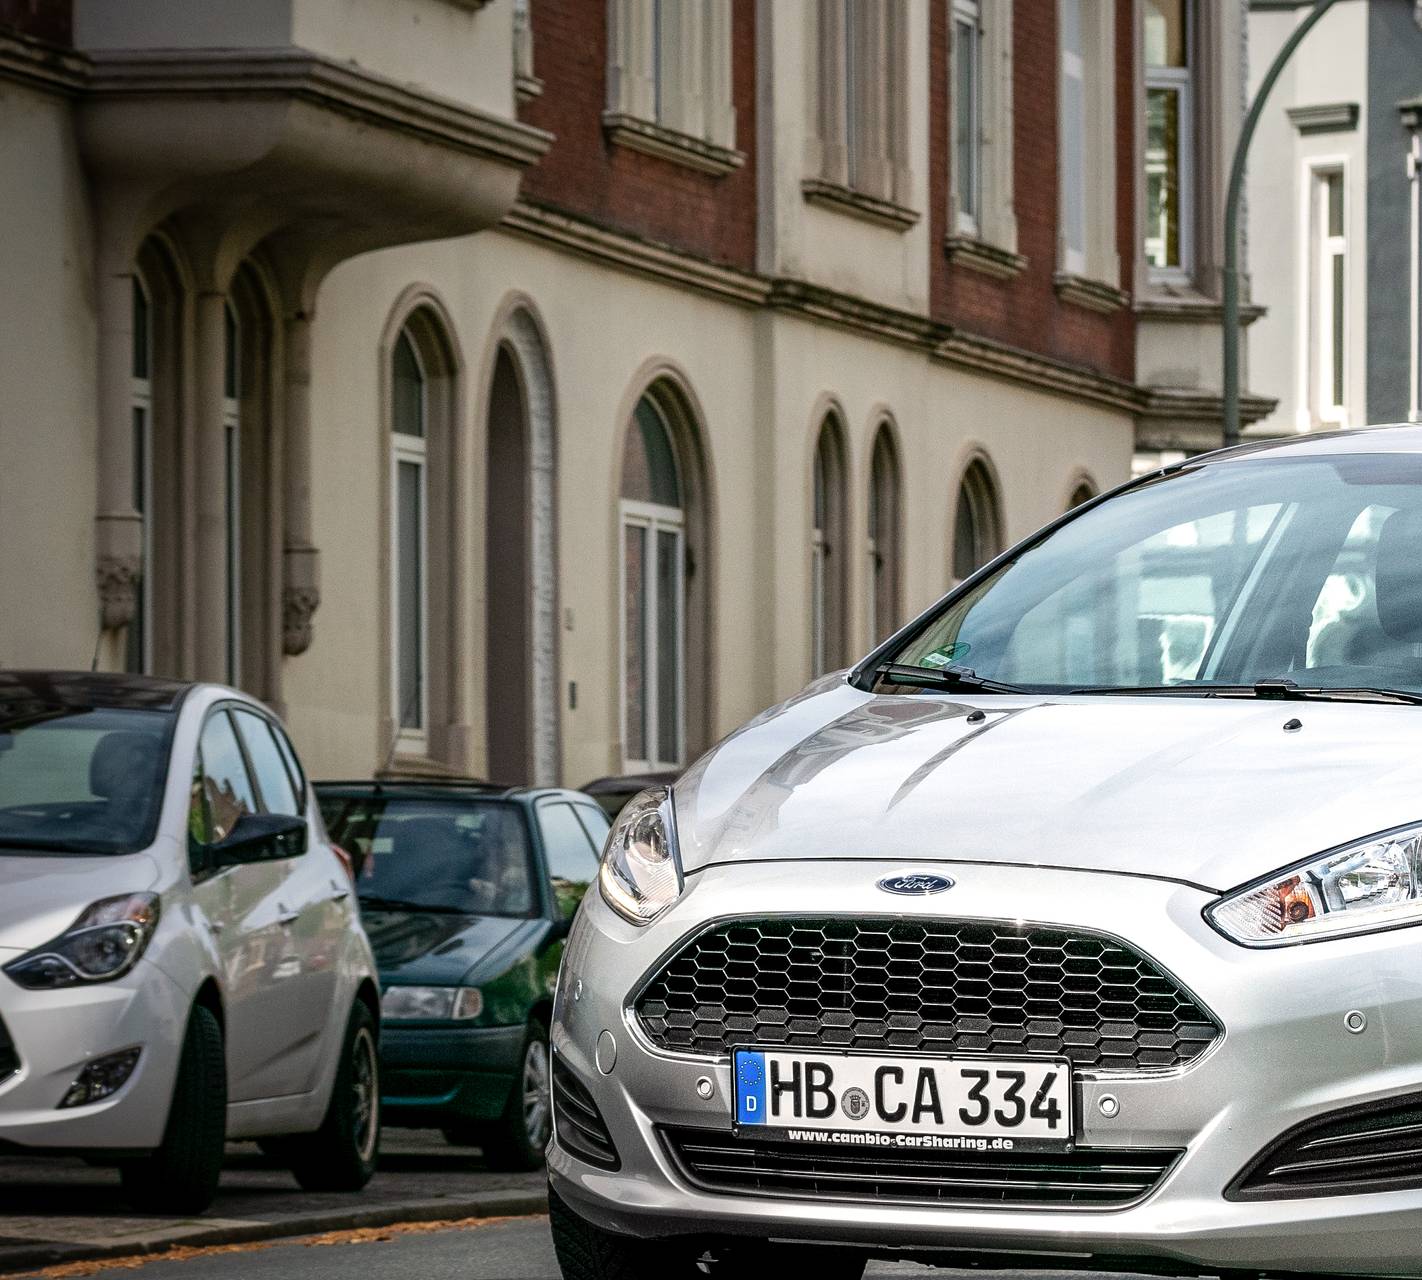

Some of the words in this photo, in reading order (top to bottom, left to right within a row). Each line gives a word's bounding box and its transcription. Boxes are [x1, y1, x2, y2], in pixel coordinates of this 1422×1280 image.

[894, 875, 937, 889] Ford
[746, 1095, 757, 1112] D
[770, 1059, 836, 1118] HB
[875, 1066, 944, 1125] CA
[958, 1069, 1062, 1129] 334
